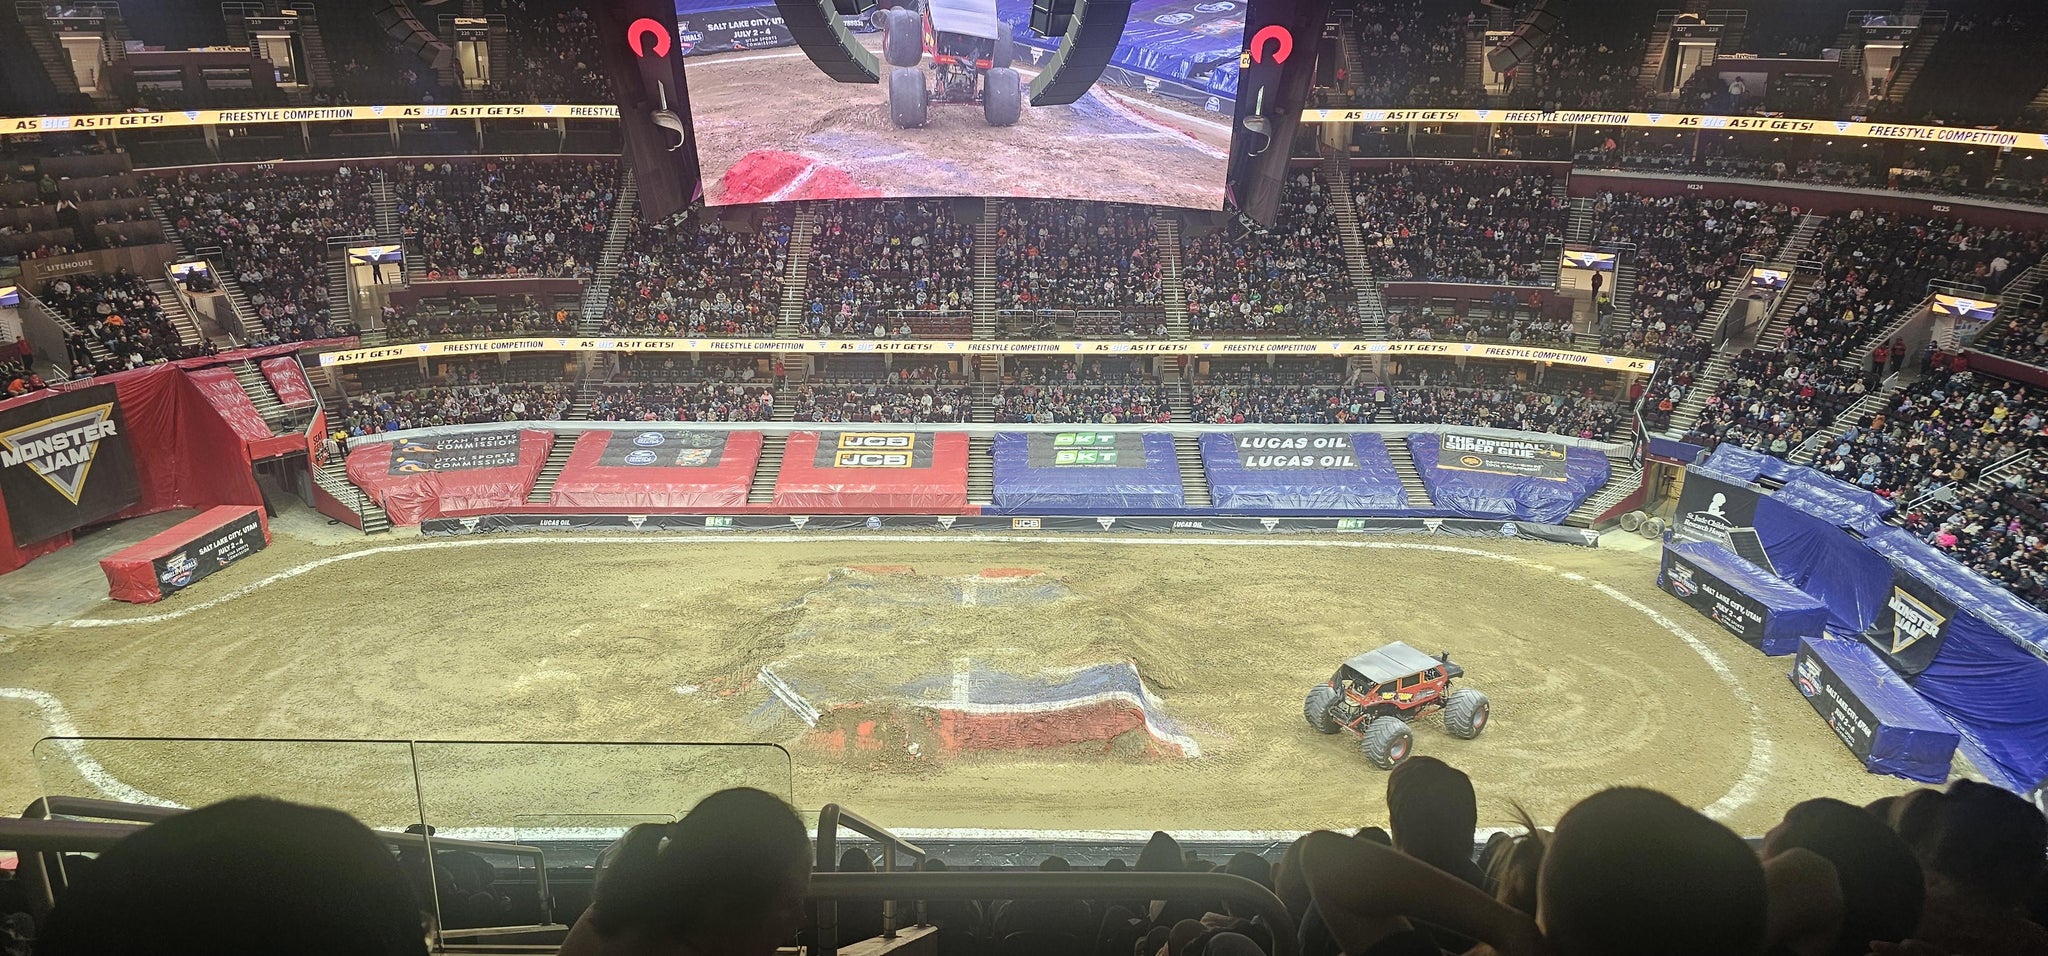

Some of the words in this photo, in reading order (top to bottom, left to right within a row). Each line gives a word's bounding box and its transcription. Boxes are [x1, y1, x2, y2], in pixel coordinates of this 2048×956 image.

[707, 23, 727, 31] SALT
[728, 20, 750, 29] LAKE
[734, 29, 752, 39] JULY
[219, 112, 279, 122] FREESTYLE
[283, 109, 353, 120] COMPETITION
[404, 108, 420, 116] AS
[450, 107, 468, 115] AS
[471, 107, 483, 115] IT
[487, 107, 524, 115] GETS!
[570, 107, 620, 117] FREESTYLE
[16, 121, 37, 130] AS
[74, 119, 95, 127] AS
[99, 118, 115, 126] IT
[119, 115, 164, 125] GETS!
[1505, 112, 1559, 122] FREESTYLE
[1562, 113, 1629, 124] COMPETITION
[1679, 117, 1698, 125] AS
[1729, 119, 1749, 127] AS
[1771, 121, 1814, 131] GETS!
[1868, 125, 1934, 139] FREESTYLE
[1937, 130, 2019, 146] COMPETITION
[46, 260, 94, 271] LITEHOUSE
[443, 343, 488, 352] FREESTYLE
[491, 341, 544, 350] COMPETITION
[711, 342, 751, 350] FREESTYLE
[754, 342, 804, 350] COMPETITION
[1010, 344, 1060, 352] COMPETITION
[337, 354, 353, 362] AS
[355, 352, 366, 360] IT
[370, 349, 403, 359] GETS!
[1485, 348, 1530, 358] FREESTYLE
[1532, 351, 1588, 363] COMPETITION
[1628, 361, 1644, 369] AS
[0, 419, 118, 468] MONSTER
[436, 439, 516, 450] COMMISSION
[474, 434, 517, 443] SPORTS
[844, 436, 909, 447] JCB
[1056, 434, 1115, 446] BKT
[1240, 437, 1308, 449] LUCAS
[1446, 434, 1474, 446] THE
[1476, 439, 1545, 452] ORIGINAL
[471, 452, 515, 461] SPORTS
[1445, 443, 1493, 454] SUPER
[1497, 447, 1535, 460] GLUE
[40, 444, 91, 476] JAM
[840, 454, 907, 466] JCB
[1057, 452, 1118, 464] BKT
[1245, 455, 1314, 467] LUCAS
[434, 459, 514, 470] COMMISSION
[705, 517, 732, 527] BKT
[1016, 520, 1039, 528] JCB
[1338, 519, 1365, 529] BKT
[1684, 518, 1709, 532] Research
[199, 544, 213, 556] SALT
[213, 537, 229, 549] LAKE
[228, 529, 243, 542] CITY,
[242, 522, 258, 535] UTAH
[218, 544, 231, 556] JULY
[1702, 584, 1716, 596] SALT
[1715, 592, 1731, 606] LAKE
[1730, 600, 1746, 615] CITY,
[1745, 609, 1762, 625] UTAH
[1716, 602, 1730, 615] JULY
[1888, 596, 1940, 639] MONSTER
[1896, 617, 1921, 640] JAM
[1826, 684, 1839, 700] SALT
[1857, 720, 1872, 738] UTAH
